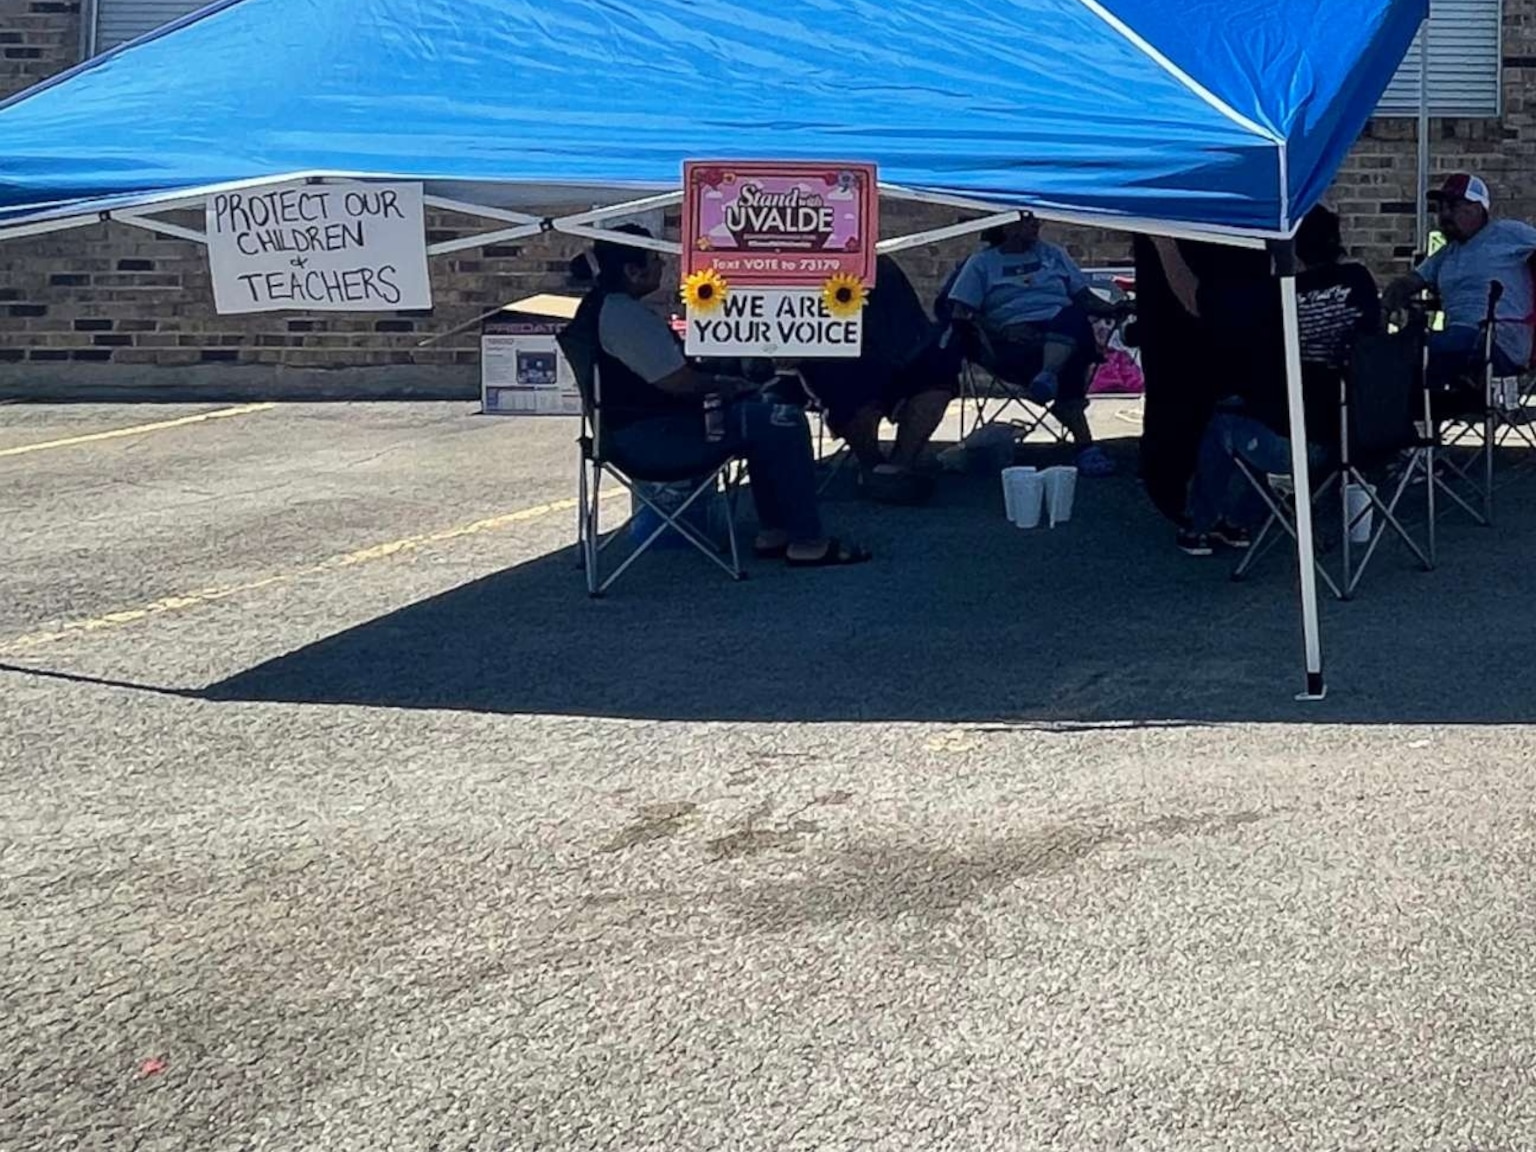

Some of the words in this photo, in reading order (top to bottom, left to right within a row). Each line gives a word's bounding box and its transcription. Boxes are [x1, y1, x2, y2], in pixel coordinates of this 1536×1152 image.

[738, 183, 799, 207] Stand
[214, 190, 330, 233] PROTECT
[345, 190, 405, 218] OUR
[726, 207, 834, 232] UVALDE
[236, 221, 364, 255] CHILDREN
[712, 258, 740, 270] Text
[743, 259, 779, 270] VOTE
[782, 260, 796, 270] to
[237, 265, 401, 304] TEACHERS
[723, 295, 765, 318] WE
[775, 296, 831, 318] ARE
[694, 320, 771, 343] YOUR
[776, 321, 858, 344] VOICE
